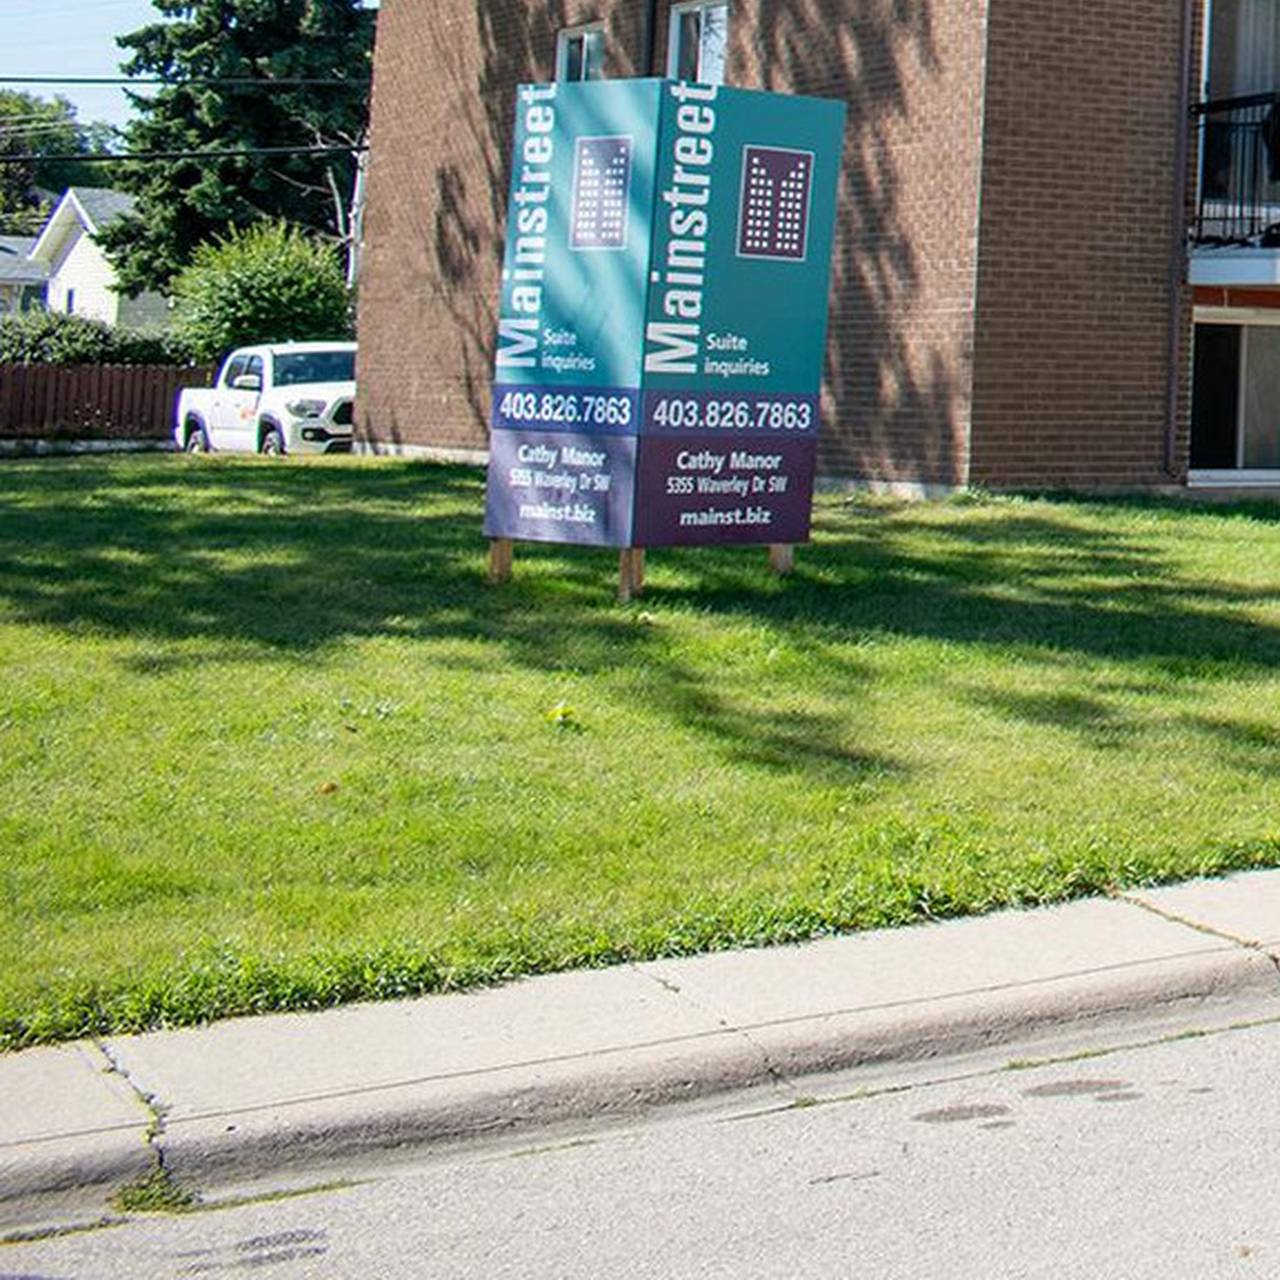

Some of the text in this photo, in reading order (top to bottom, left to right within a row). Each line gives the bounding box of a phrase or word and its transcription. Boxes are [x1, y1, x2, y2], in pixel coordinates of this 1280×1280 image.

[495, 81, 557, 368] Mainstreet
[644, 79, 719, 373] Mainstreet
[542, 327, 577, 346] Suite
[706, 332, 748, 351] Suite
[541, 351, 596, 373] inquiries
[704, 357, 770, 378] inquiries
[500, 392, 631, 425] 403.826.7863
[653, 400, 811, 429] 403.826.7863
[518, 444, 607, 469] Cathy Manor
[676, 451, 782, 474] Cathy Manor
[579, 473, 591, 490] Dr
[593, 474, 611, 491] SW
[666, 476, 695, 494] 5355
[751, 476, 766, 493] Dr
[768, 476, 788, 493] SW
[519, 501, 596, 523] mainst.biz
[680, 507, 772, 525] mainst.biz
